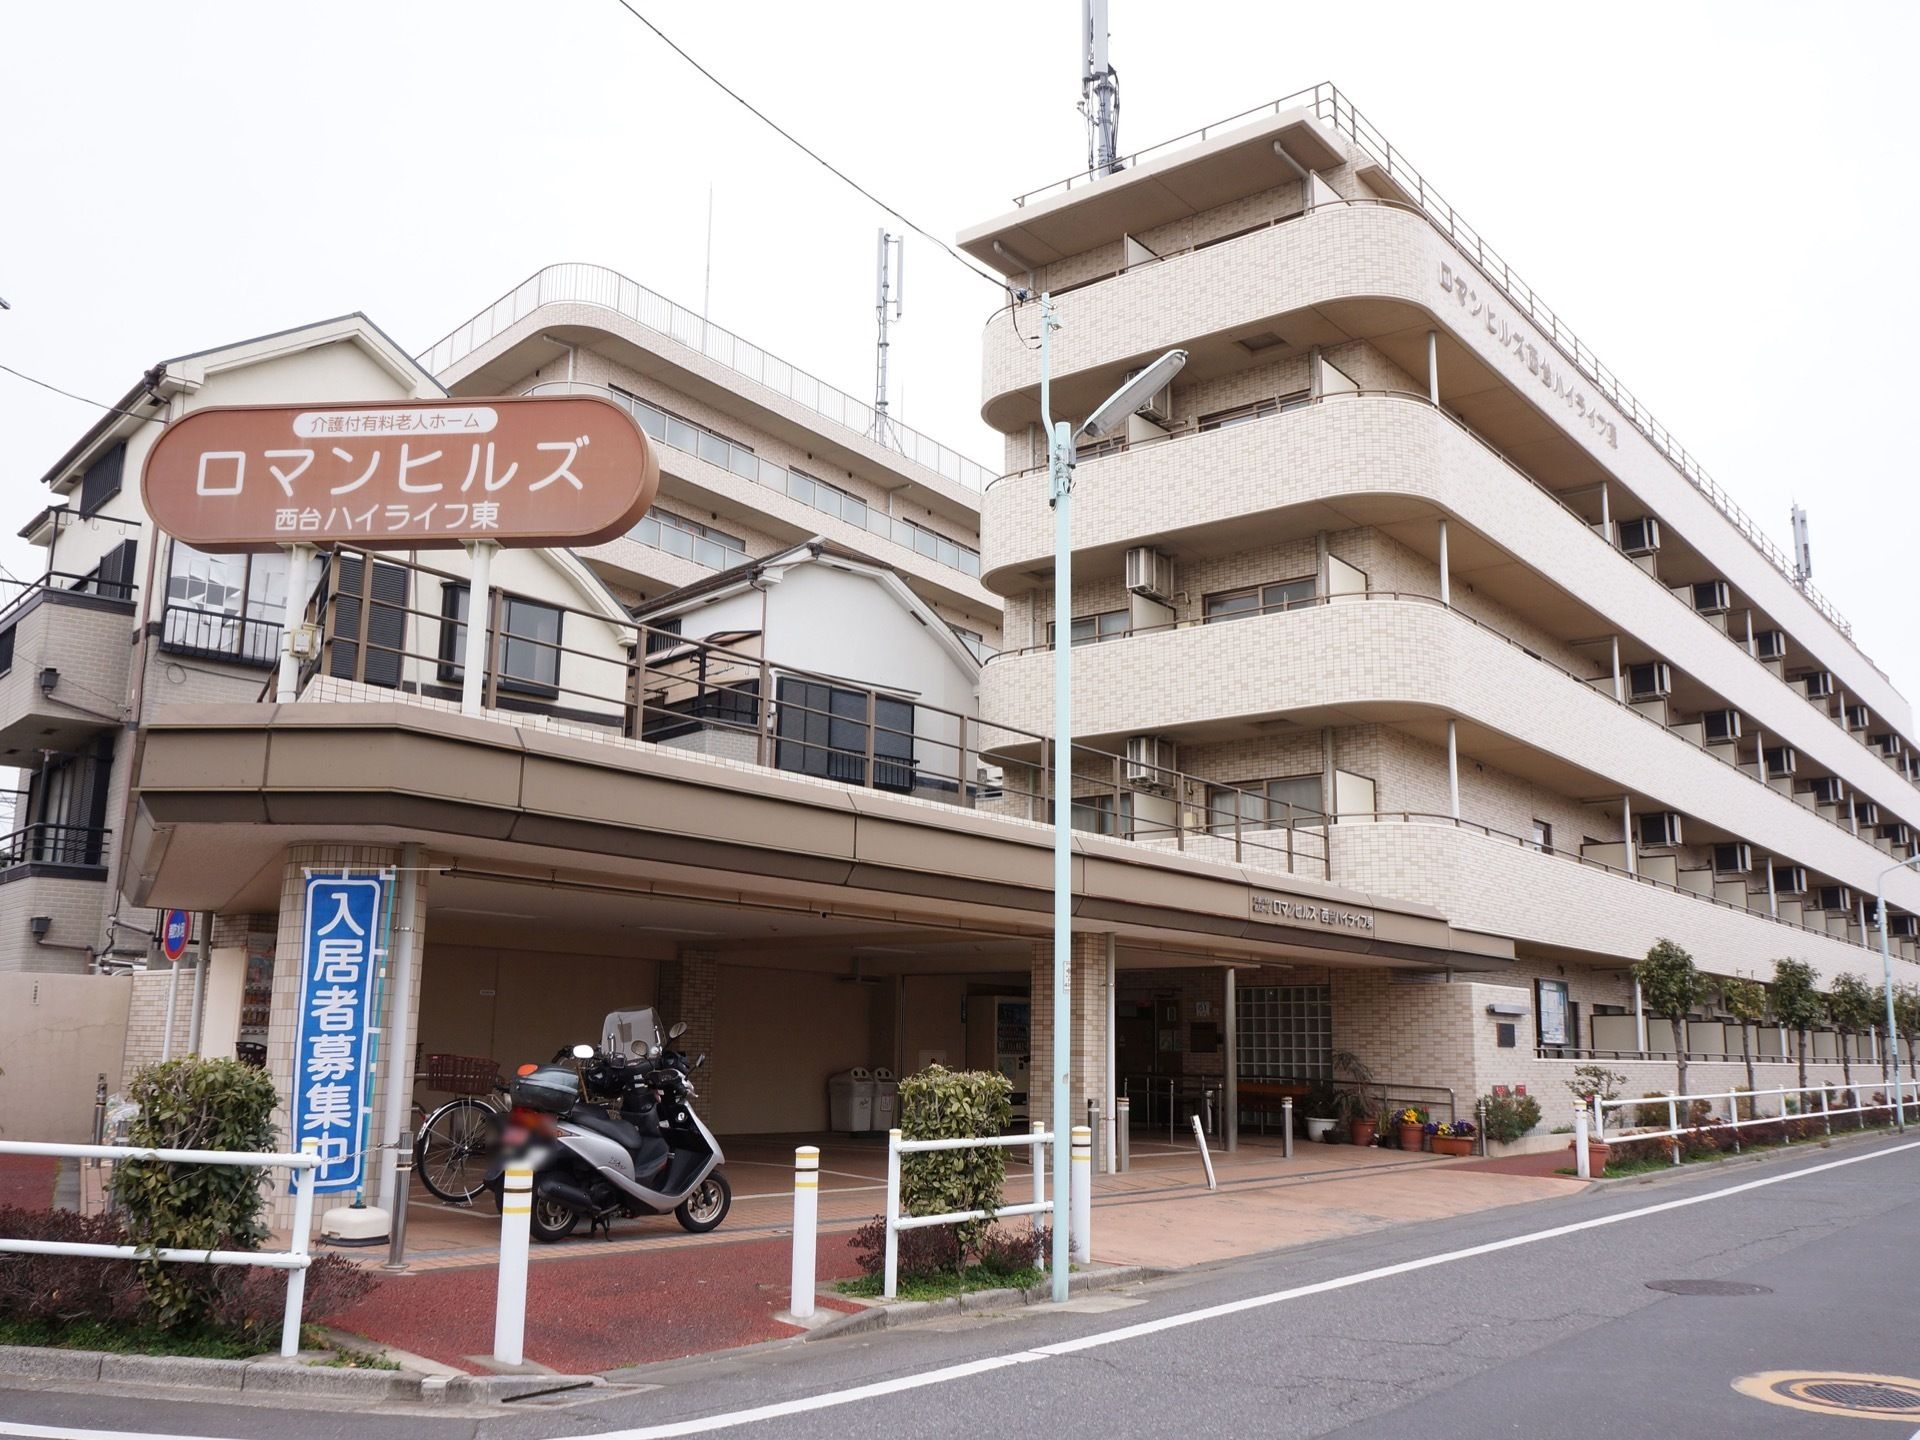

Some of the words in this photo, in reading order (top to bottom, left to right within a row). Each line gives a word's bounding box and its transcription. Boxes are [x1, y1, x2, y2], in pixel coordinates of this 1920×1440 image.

[310, 413, 480, 433] 介護付有料老人ホーム
[196, 435, 590, 497] ロマンヒルズ
[275, 500, 501, 532] 西台ハイライフ東
[302, 892, 365, 1181] 入居者募集中
